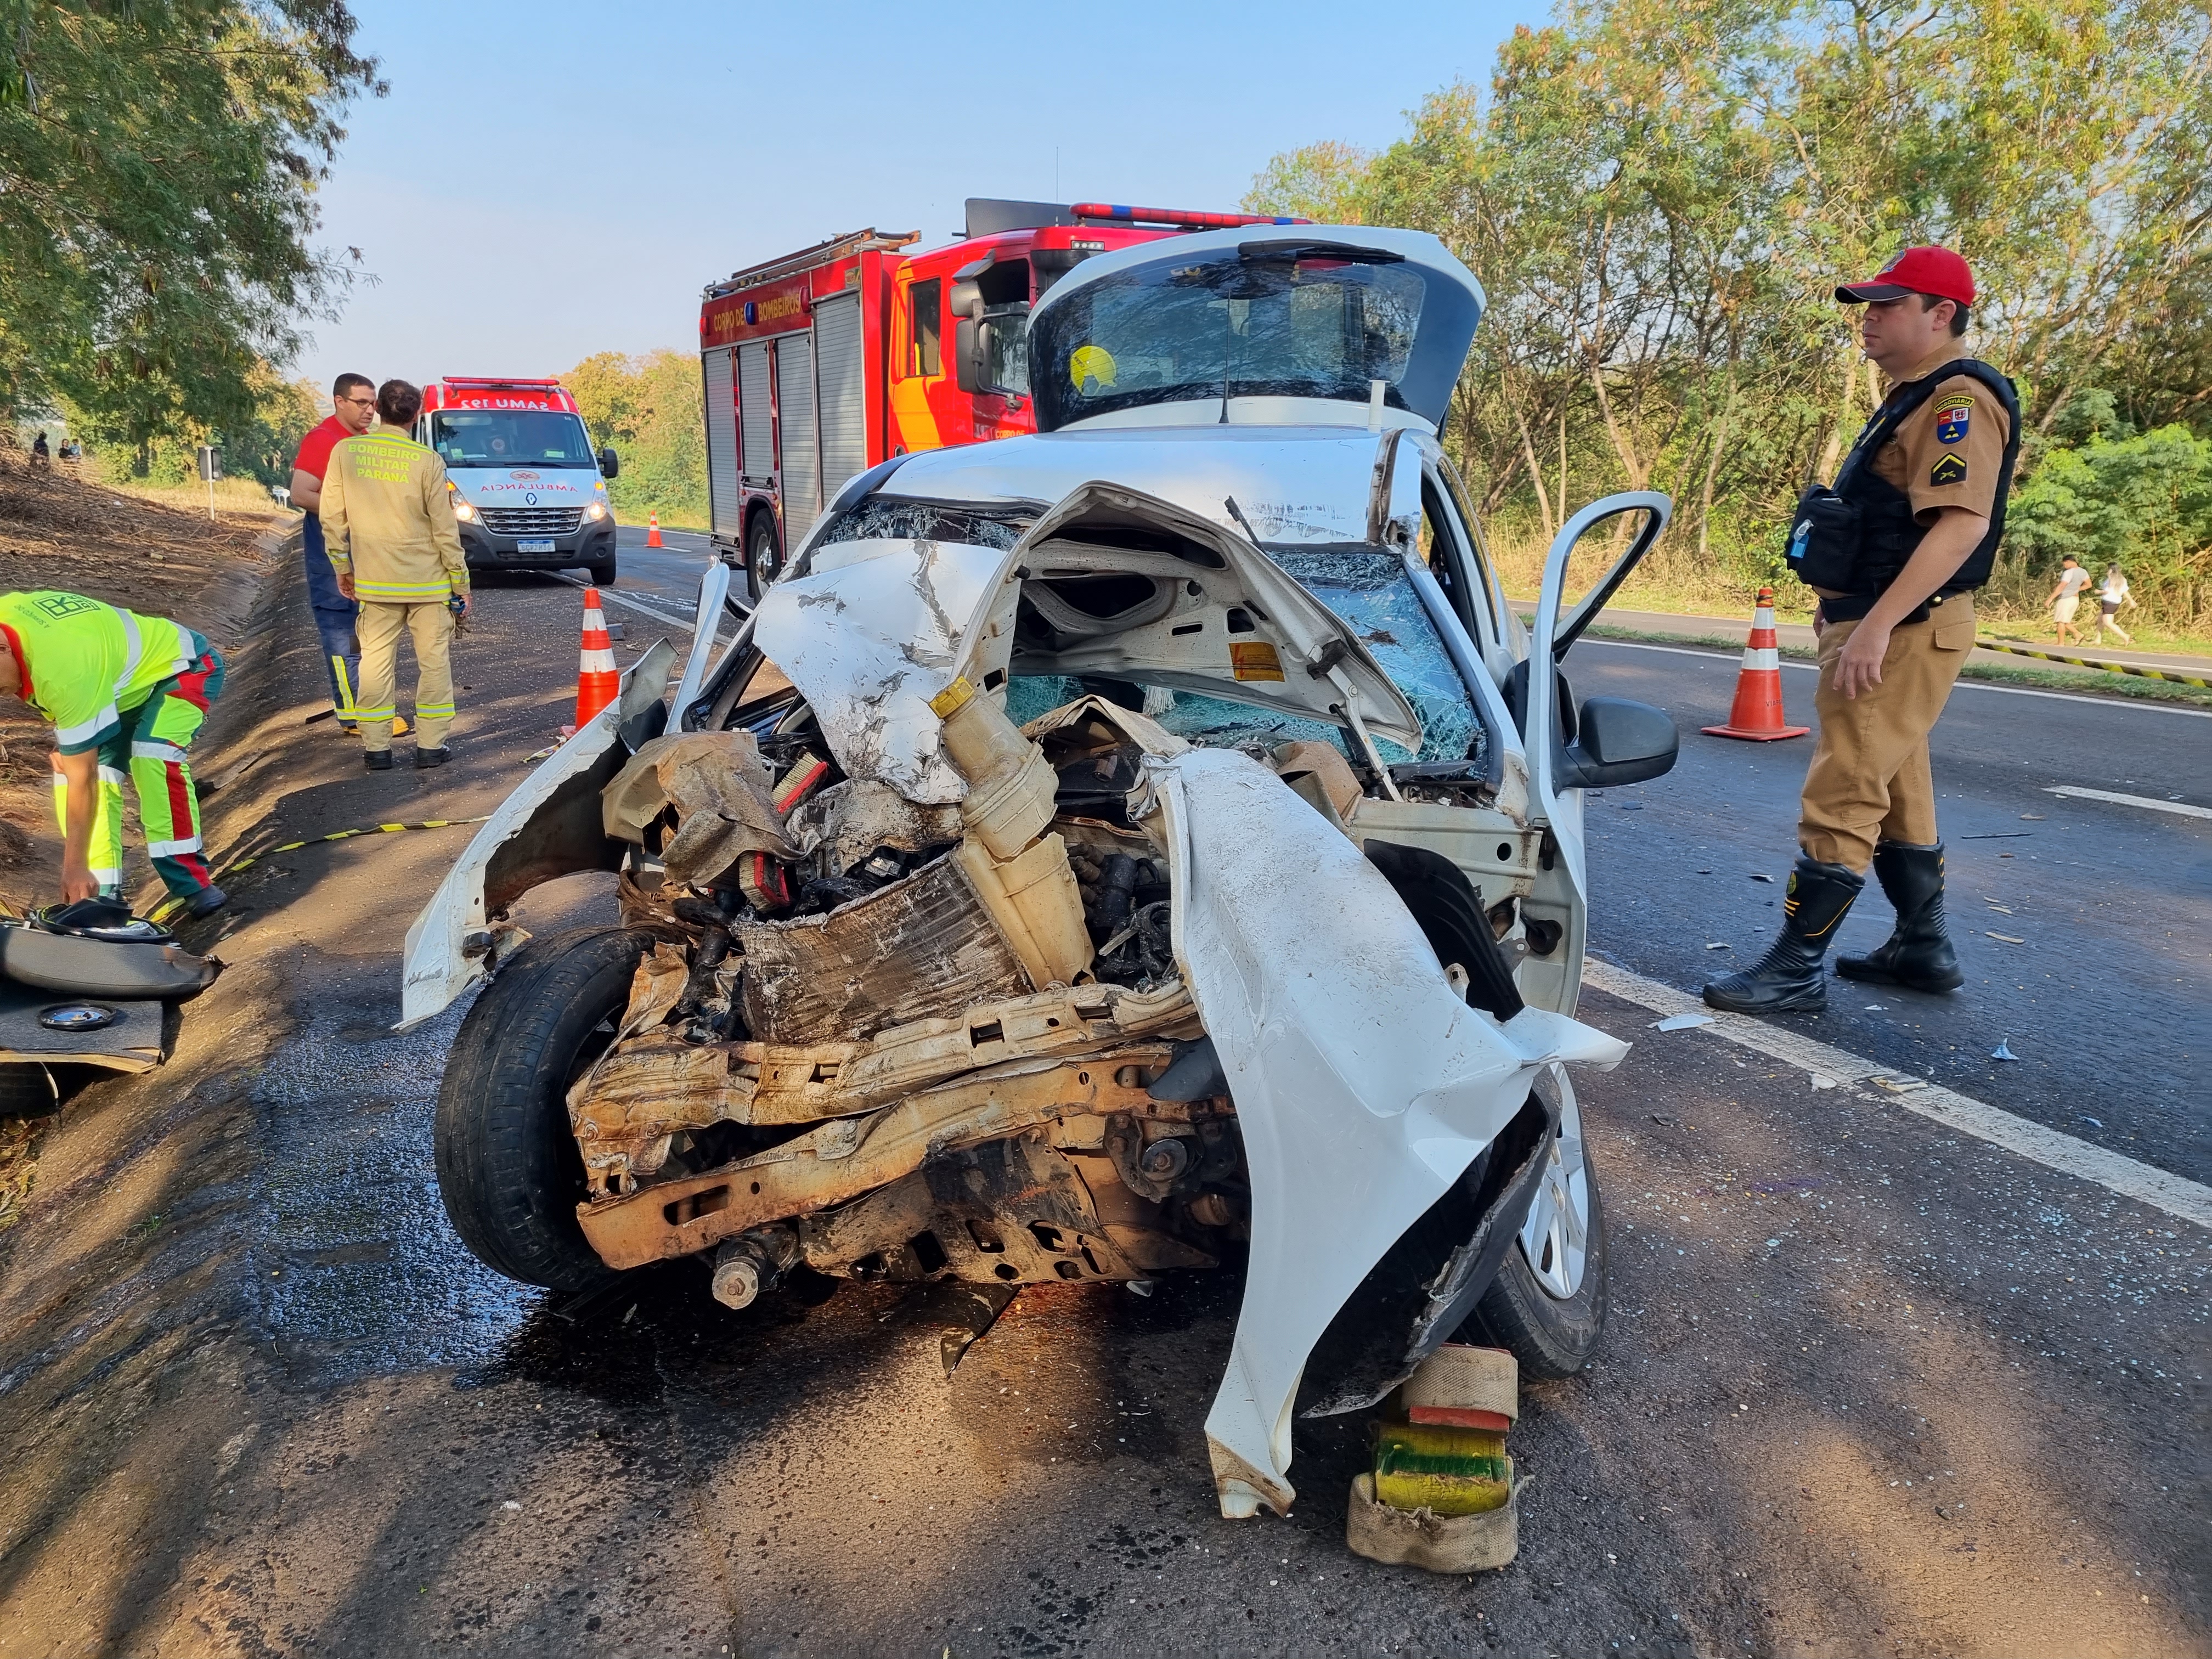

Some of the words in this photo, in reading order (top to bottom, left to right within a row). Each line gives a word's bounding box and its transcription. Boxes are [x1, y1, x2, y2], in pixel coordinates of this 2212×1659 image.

[714, 310, 735, 332] CORPO
[736, 307, 745, 327] DE
[758, 294, 800, 321] BOMBEIROS
[348, 444, 421, 461] BOMBEIRO
[356, 455, 410, 471] MILITAR
[357, 467, 409, 484] PARANÁ
